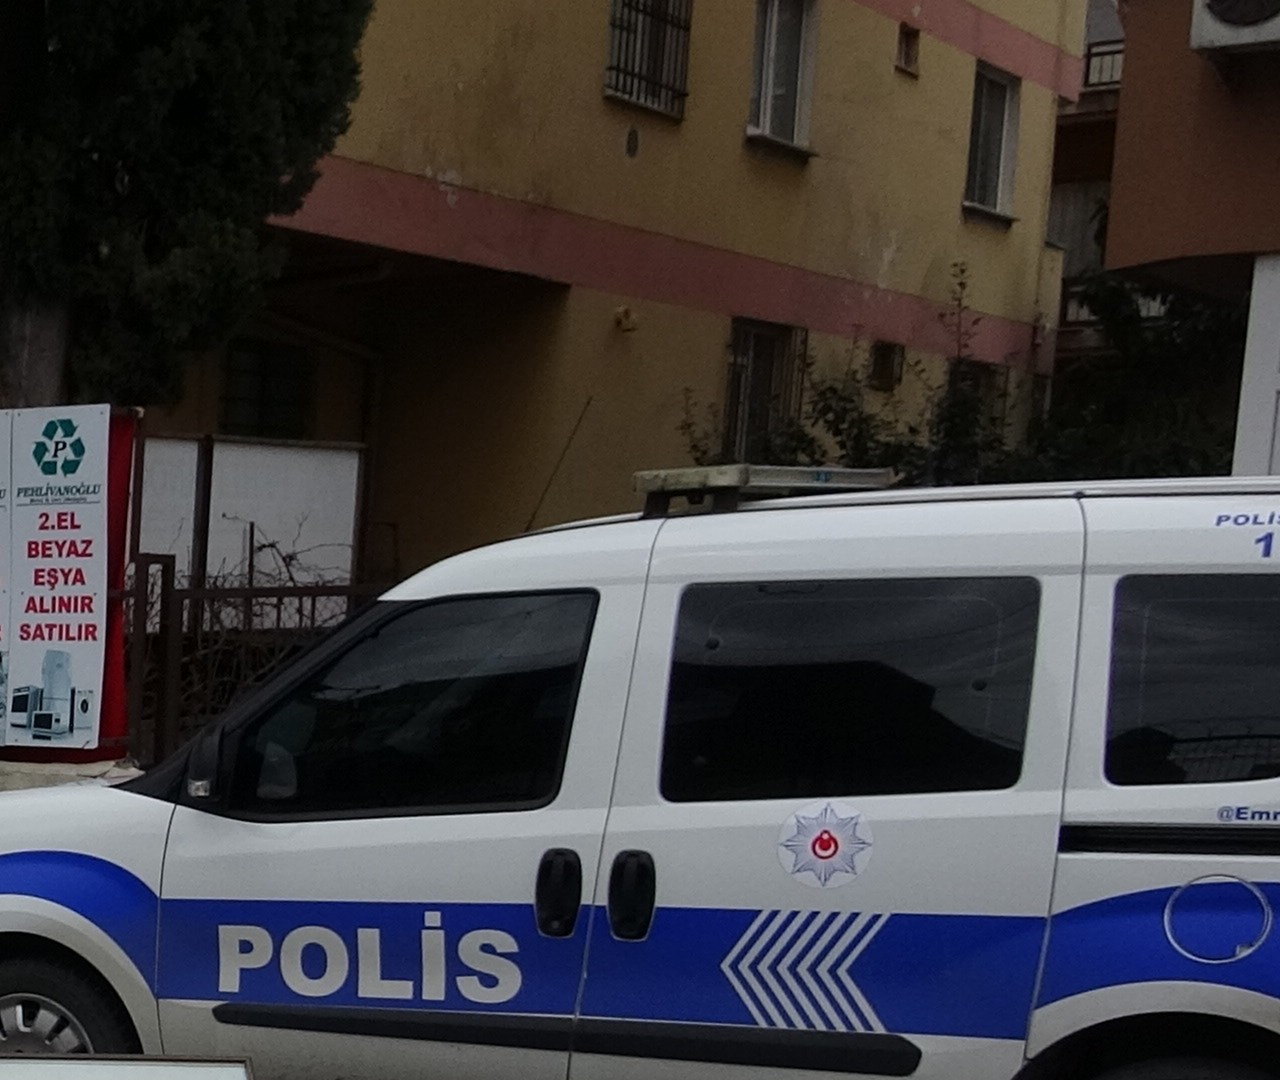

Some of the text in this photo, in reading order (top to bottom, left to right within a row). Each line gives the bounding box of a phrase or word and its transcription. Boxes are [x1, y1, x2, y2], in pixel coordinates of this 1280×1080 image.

[38, 511, 82, 531] 2.EL
[27, 538, 94, 559] BEYAZ
[33, 567, 86, 591] EŞYA
[24, 594, 95, 615] ALINIR
[19, 622, 98, 642] SATILIR
[217, 910, 523, 1004] POLİS
